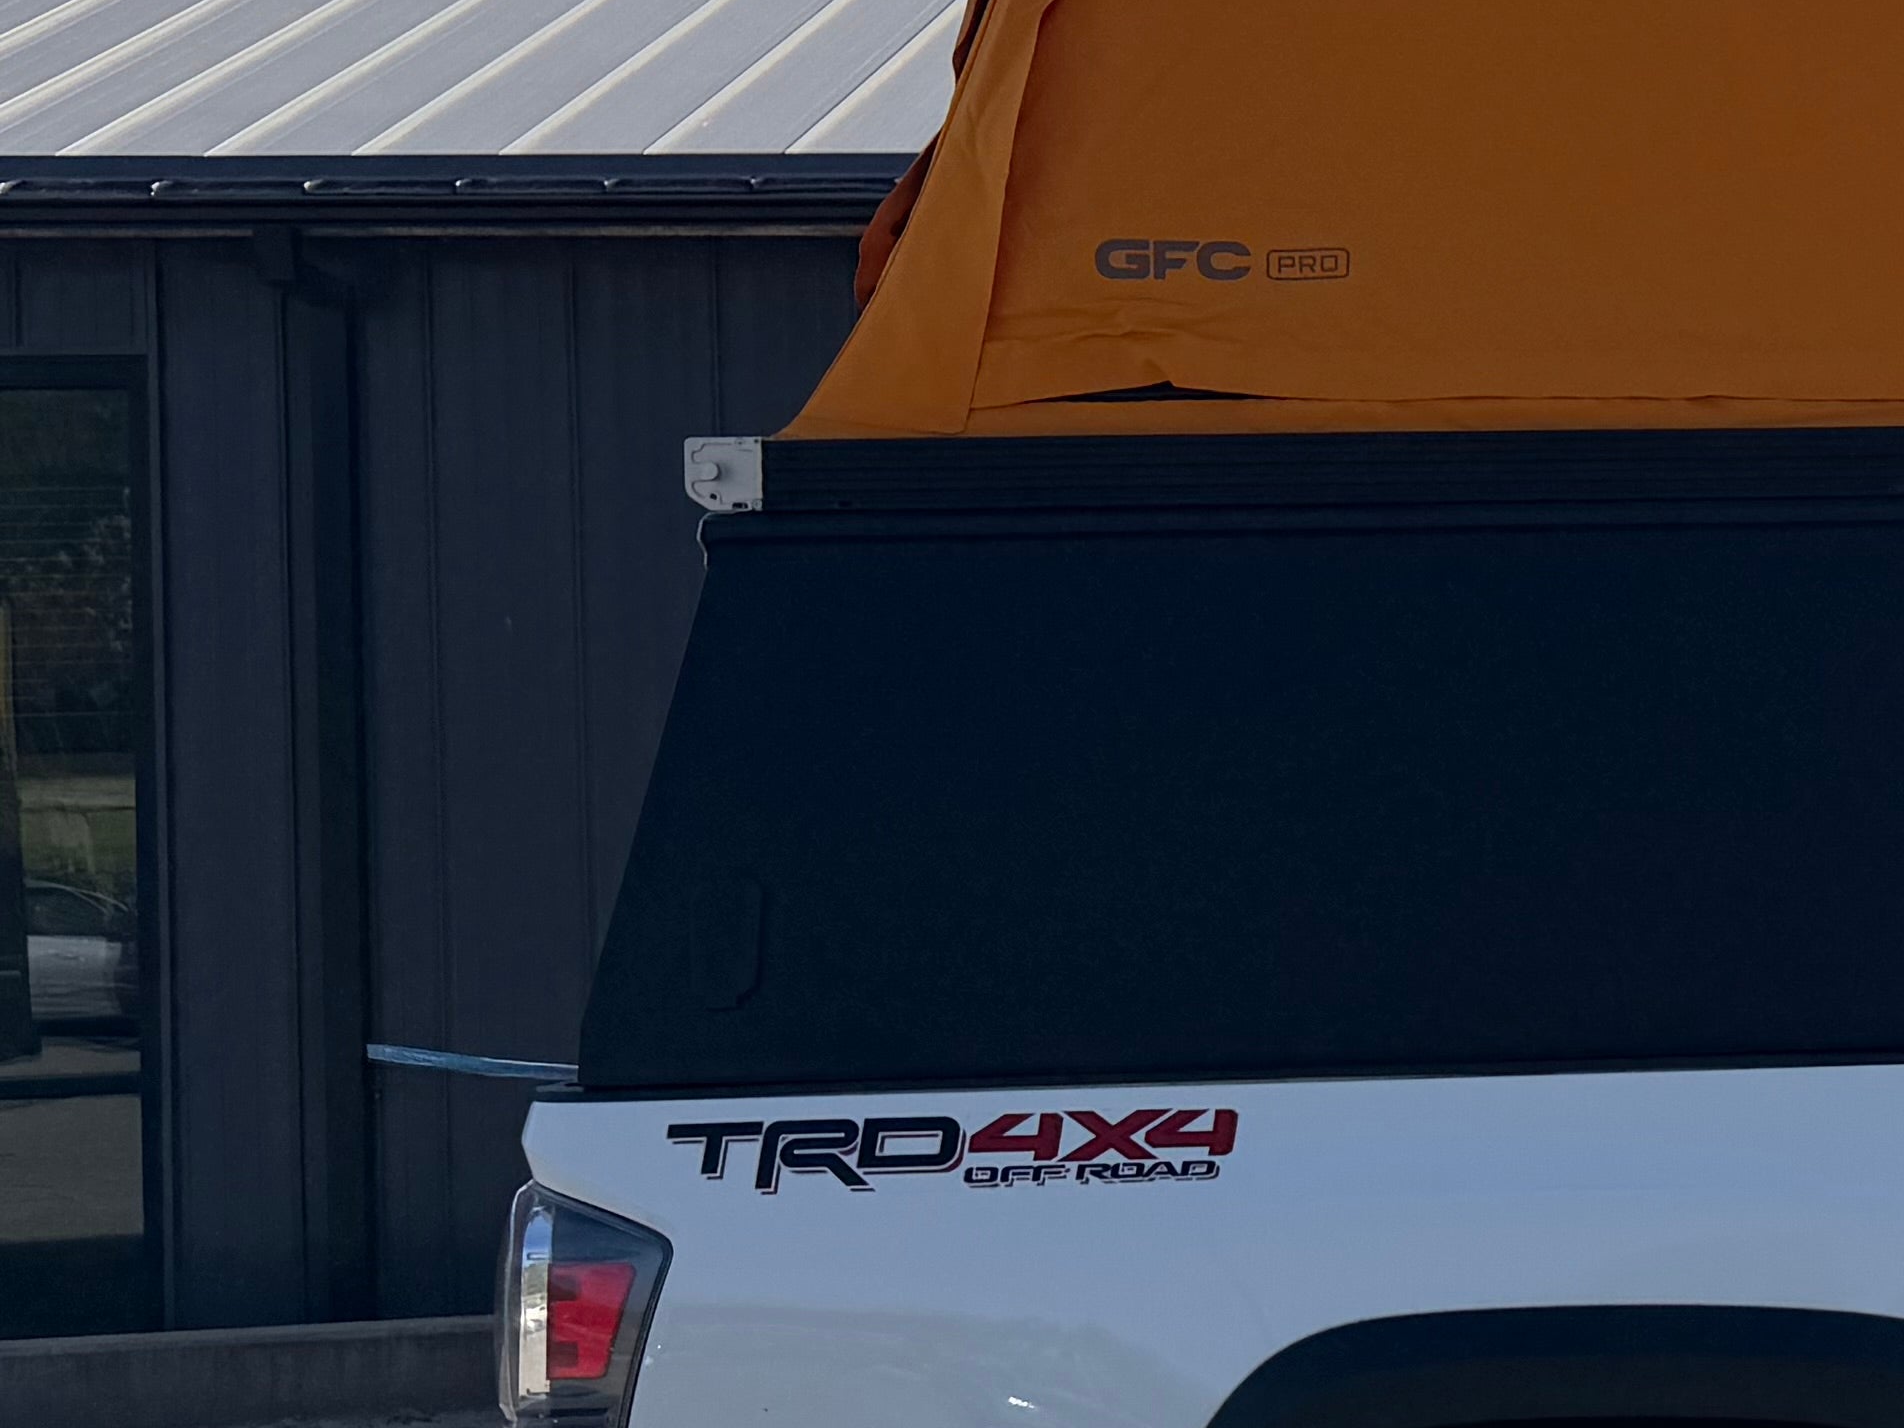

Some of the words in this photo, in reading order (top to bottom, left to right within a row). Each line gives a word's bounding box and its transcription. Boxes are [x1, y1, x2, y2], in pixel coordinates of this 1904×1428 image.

[1094, 237, 1252, 281] GFC
[1277, 253, 1339, 274] PRO
[667, 1115, 968, 1194] TRD
[962, 1162, 1068, 1188] OFF
[1074, 1159, 1220, 1185] ROAD
